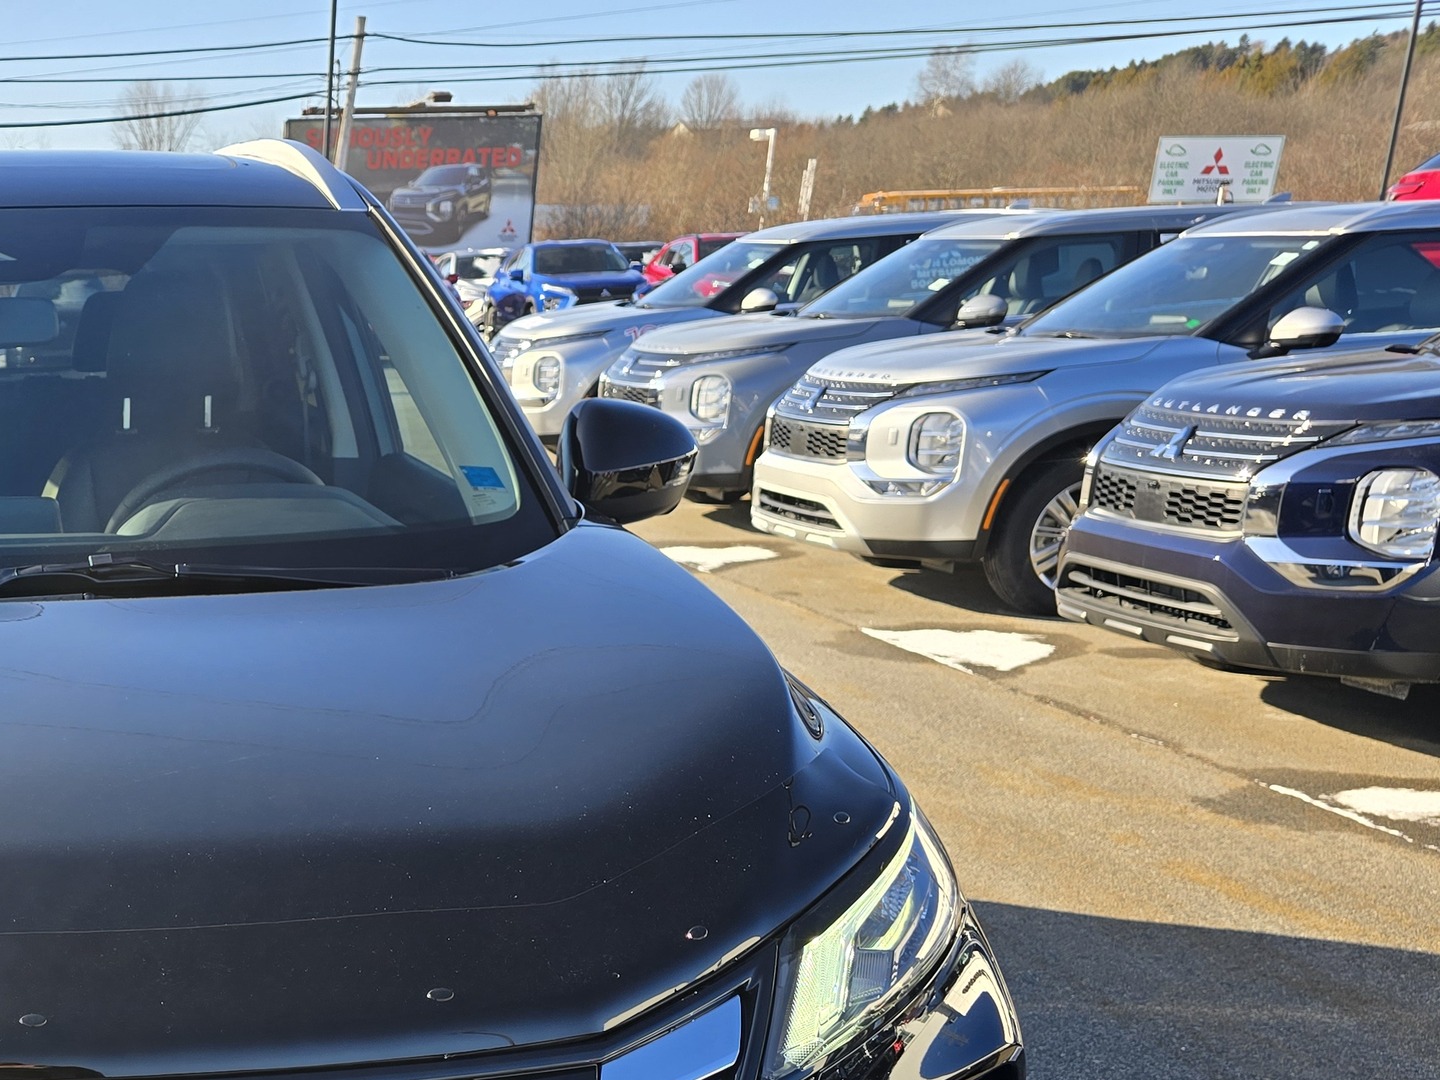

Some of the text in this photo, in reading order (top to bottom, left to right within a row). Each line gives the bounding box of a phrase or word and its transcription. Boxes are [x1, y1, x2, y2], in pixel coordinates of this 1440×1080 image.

[305, 126, 434, 149] SIOUSLY
[367, 147, 522, 170] UNDERRATED
[1152, 397, 1311, 420] OUTLANDER
